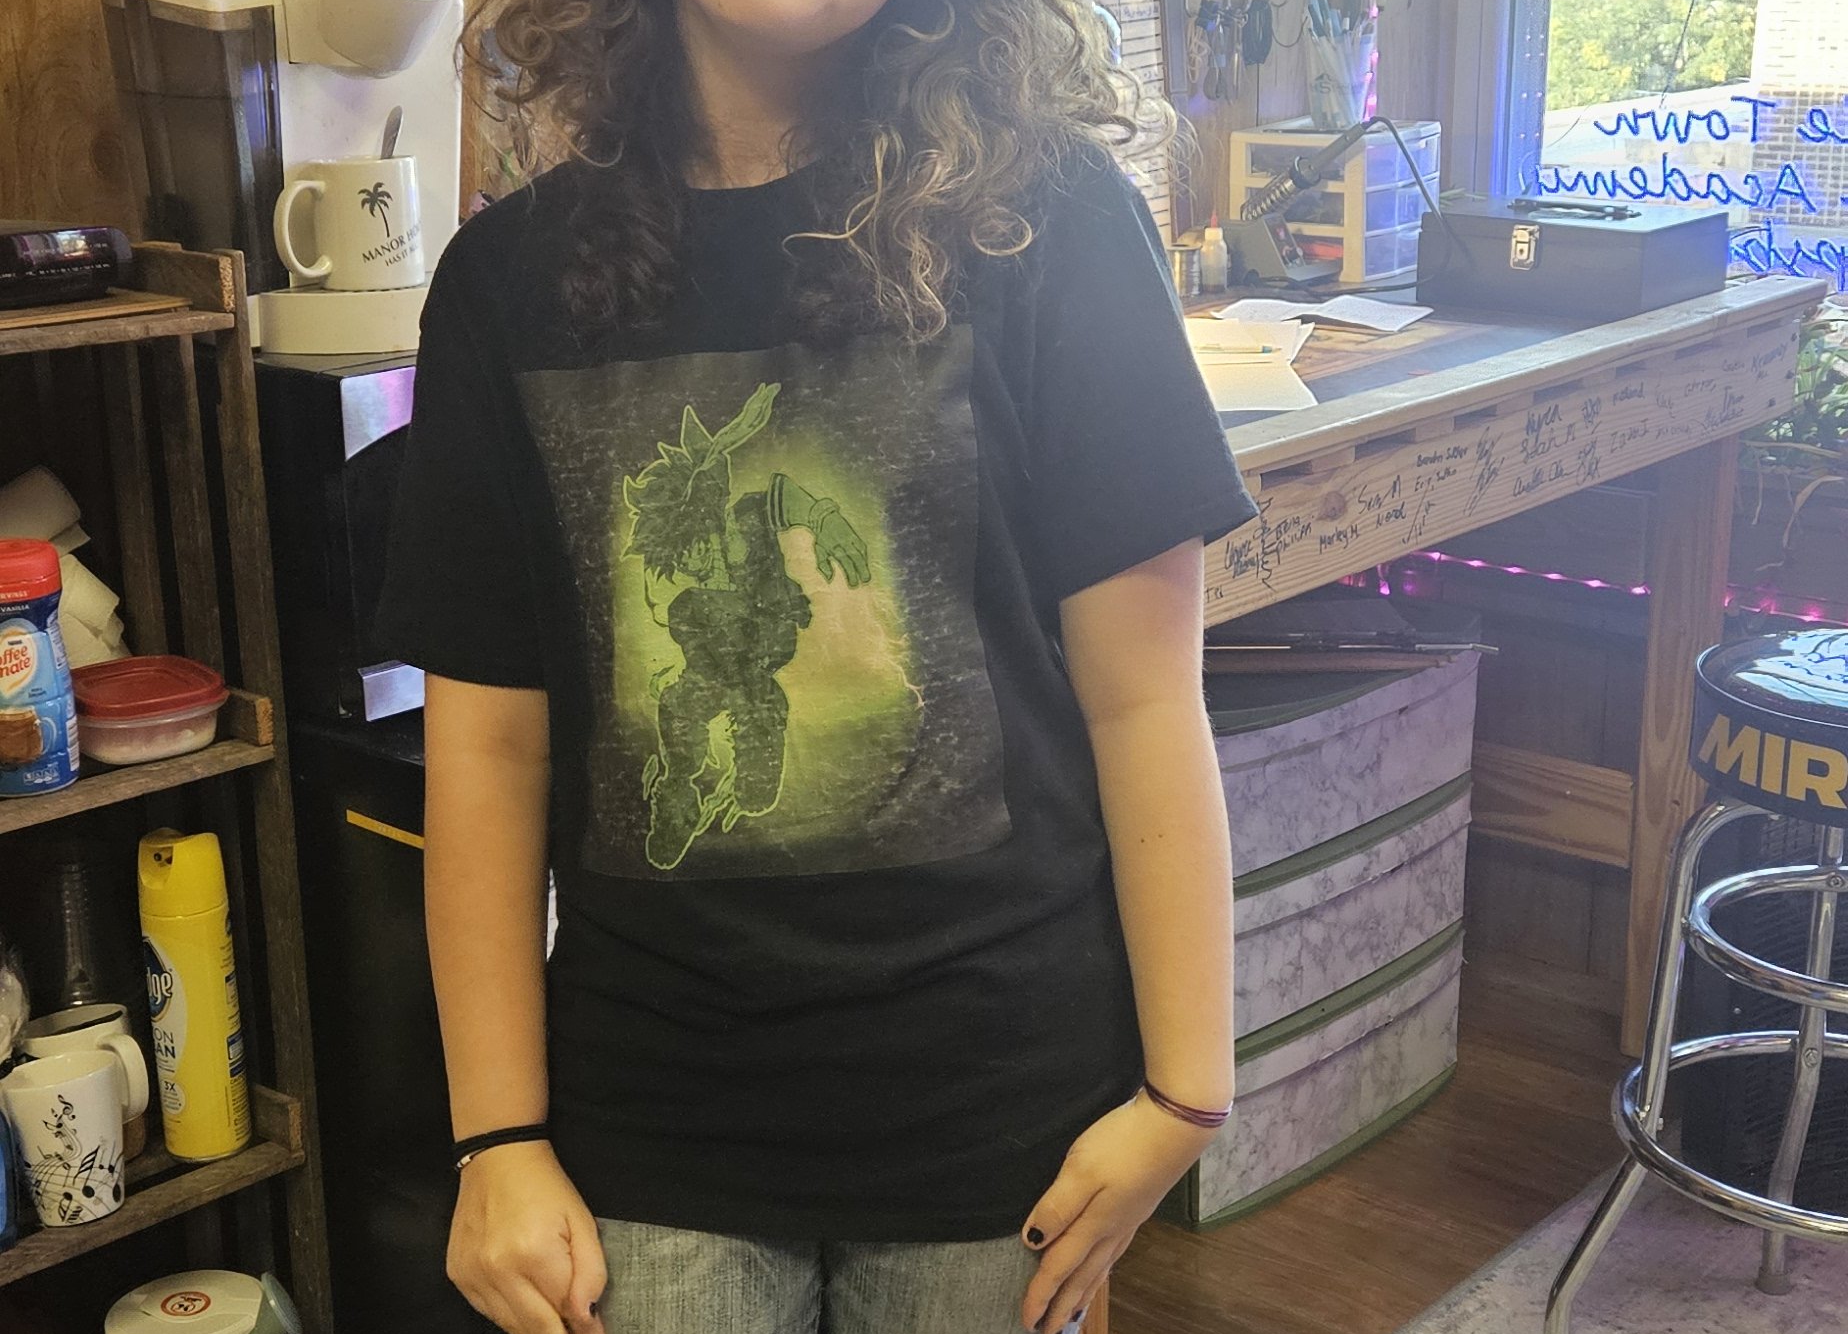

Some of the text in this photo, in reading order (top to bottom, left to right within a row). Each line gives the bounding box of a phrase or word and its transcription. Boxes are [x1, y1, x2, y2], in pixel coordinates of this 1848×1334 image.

[362, 234, 405, 263] MANOR
[0, 591, 28, 600] RVINGS
[1, 604, 30, 613] VANILLA
[1698, 713, 1848, 810] MIR
[164, 1080, 176, 1092] 3X
